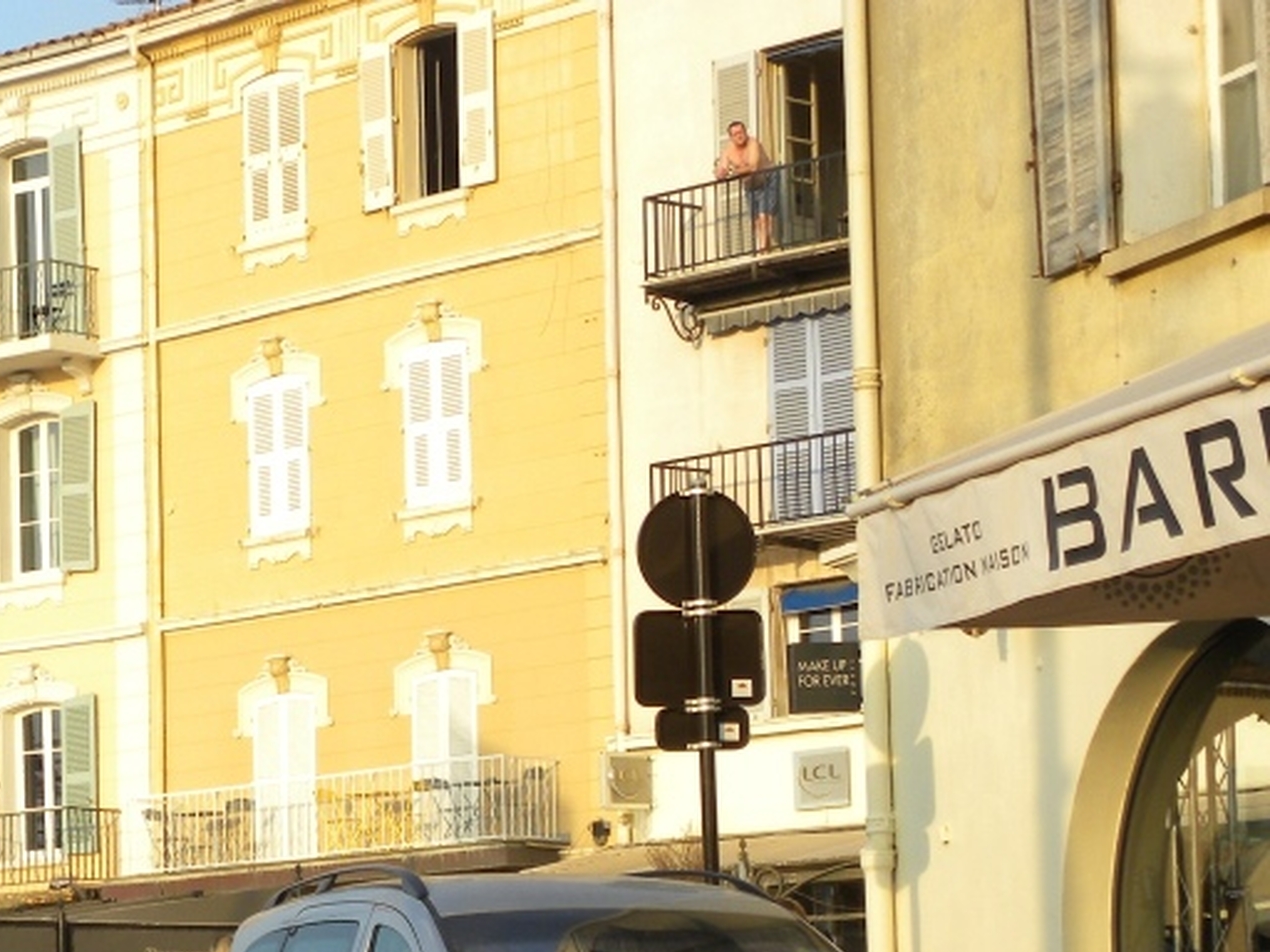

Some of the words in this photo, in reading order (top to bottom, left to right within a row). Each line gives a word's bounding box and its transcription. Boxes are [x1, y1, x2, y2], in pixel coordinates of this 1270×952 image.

[929, 520, 983, 555] GELATO
[884, 560, 978, 603] FABRICATION
[980, 541, 1031, 577] MAISON
[797, 659, 830, 672] MAKE
[832, 659, 847, 671] UP
[797, 674, 821, 689] FOR
[822, 673, 850, 688] EVER
[802, 763, 842, 782] LCL
